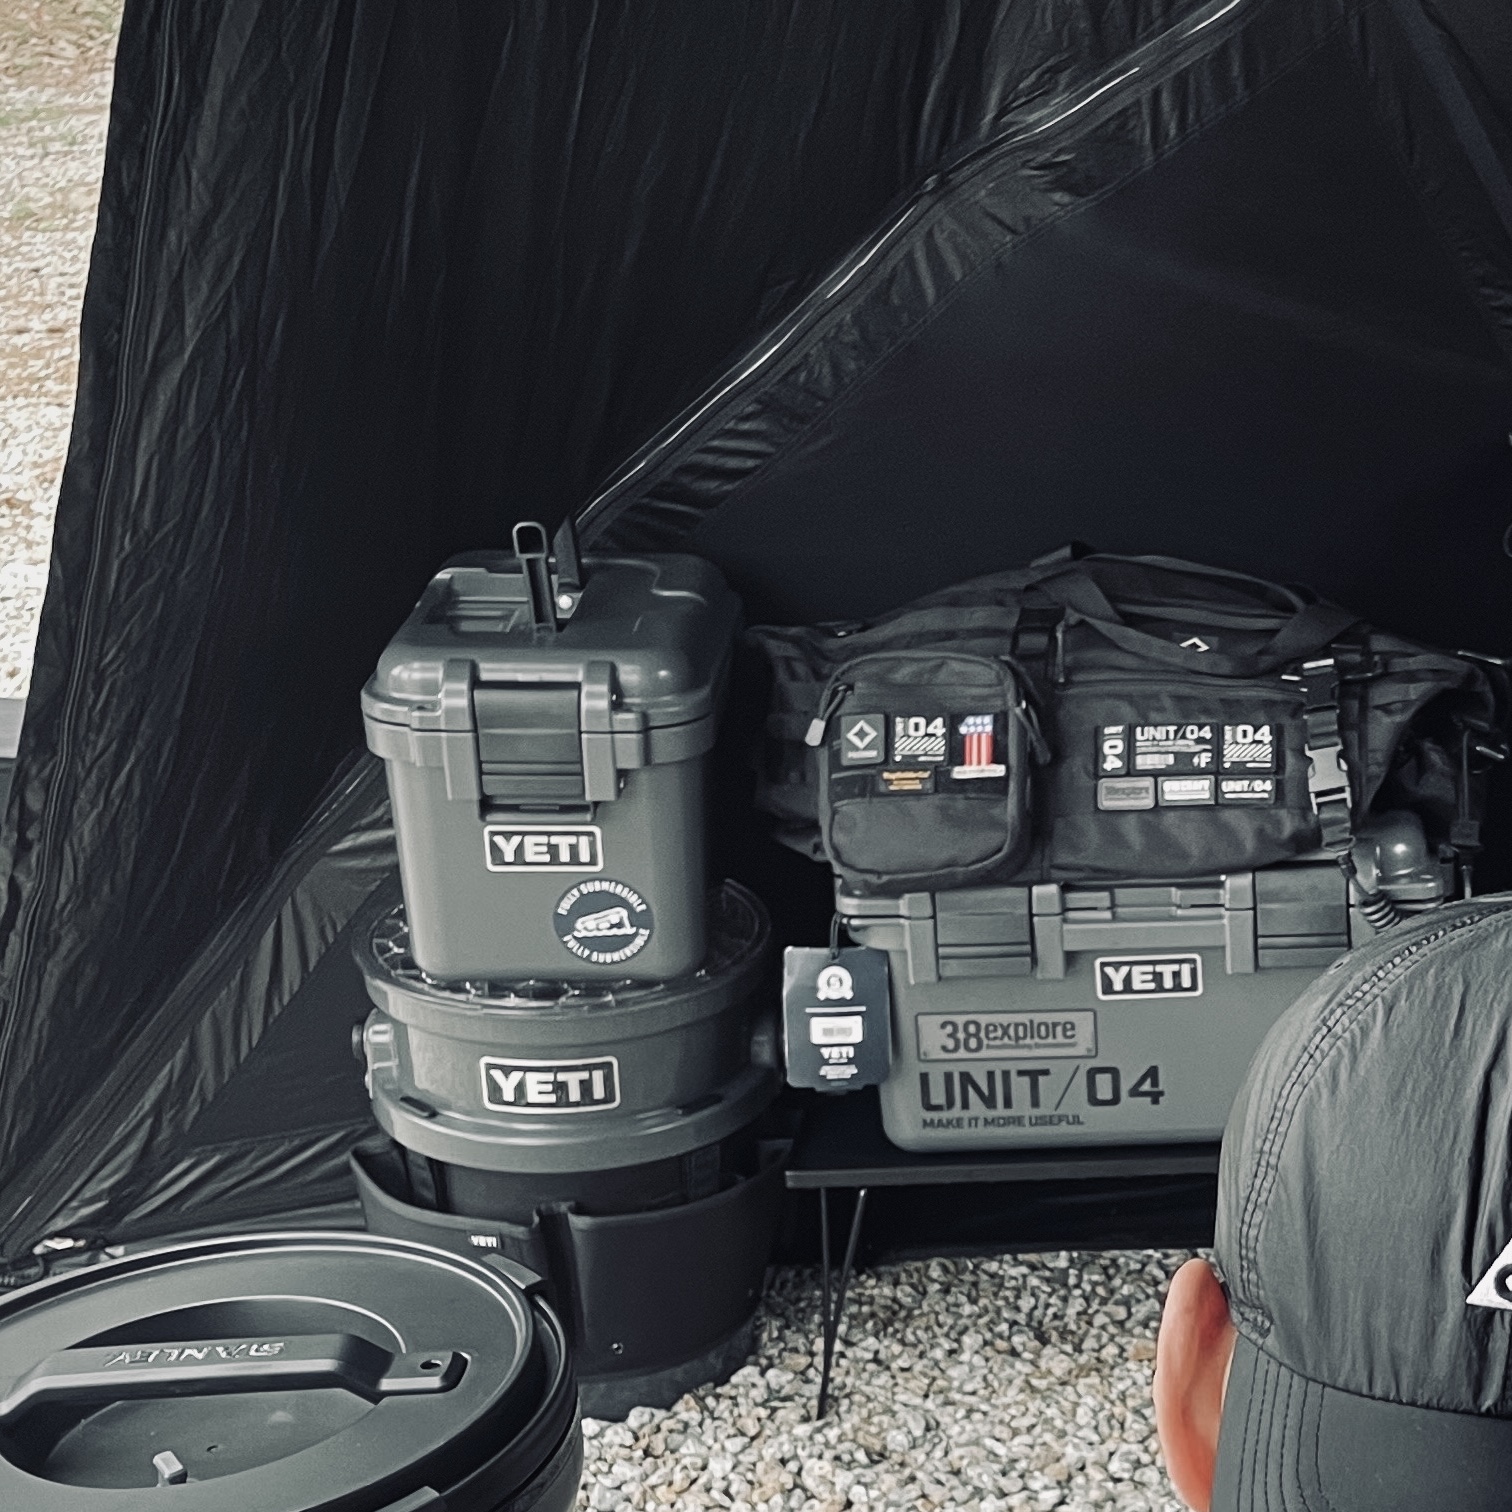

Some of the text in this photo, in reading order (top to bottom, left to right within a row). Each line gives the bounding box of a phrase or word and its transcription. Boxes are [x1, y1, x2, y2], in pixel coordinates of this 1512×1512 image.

[907, 716, 946, 737] 04
[1135, 725, 1213, 741] UNIT/04
[1236, 724, 1273, 745] 04
[492, 835, 592, 863] YETI
[579, 880, 648, 913] SUBMERSIBLE
[1103, 963, 1196, 992] YETI
[939, 1018, 1077, 1054] 38explore
[488, 1068, 607, 1104] YETI
[918, 1064, 1166, 1113] UNIT/04
[921, 1113, 1086, 1130] MAKE IT MORE USEFUL
